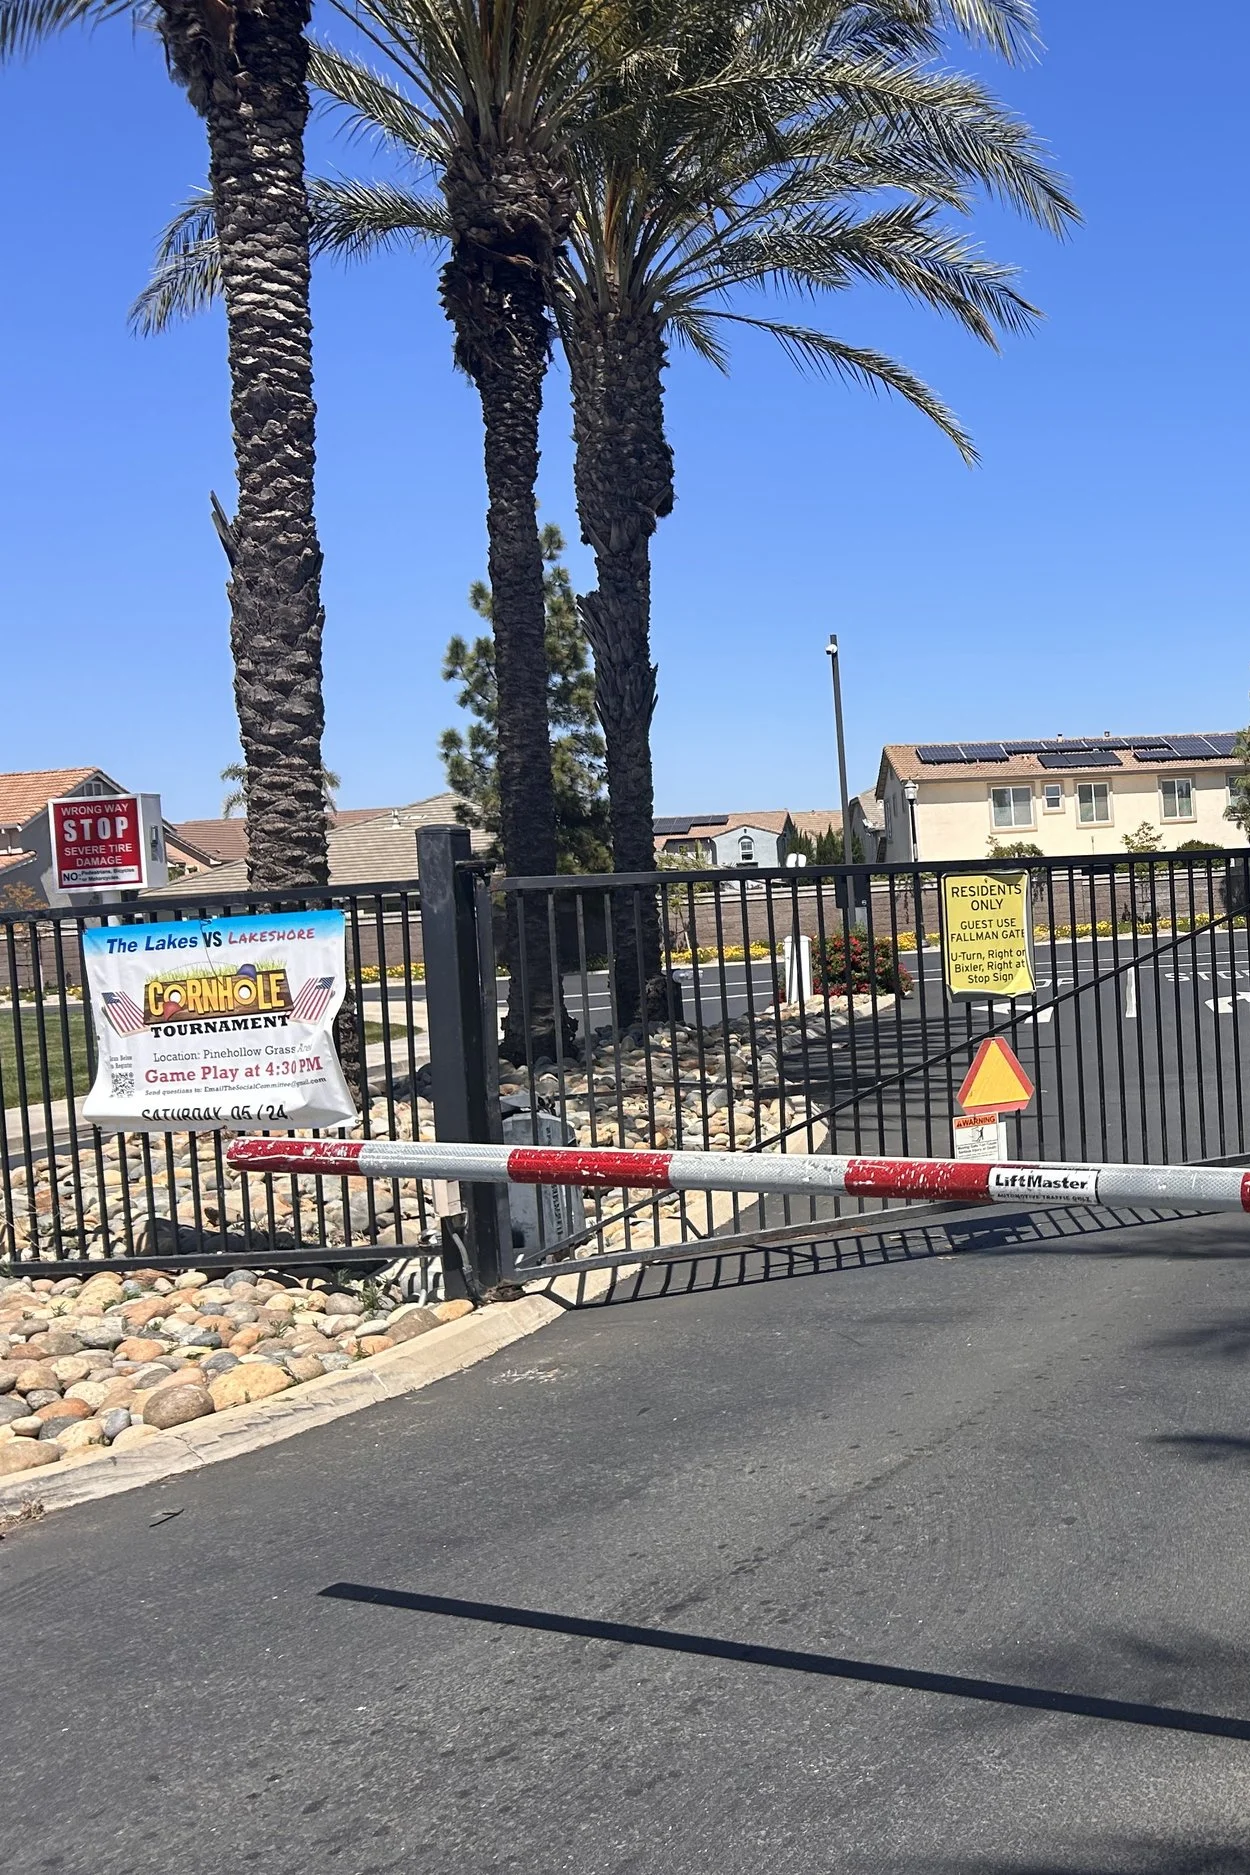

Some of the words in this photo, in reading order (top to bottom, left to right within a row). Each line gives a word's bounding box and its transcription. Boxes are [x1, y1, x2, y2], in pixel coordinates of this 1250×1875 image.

[61, 805, 102, 816] WRONG
[104, 803, 129, 813] WAY
[63, 816, 129, 842] STOP
[64, 845, 106, 856] SEVERE
[109, 843, 133, 853] TIRE
[76, 856, 123, 867] DAMAGE
[951, 883, 1022, 898] RESIDENTS
[971, 898, 1004, 911] ONLY
[960, 919, 993, 930] GUEST
[997, 917, 1017, 928] USE
[106, 937, 138, 954] The
[144, 933, 198, 951] Lakes
[202, 931, 222, 948] VS
[228, 927, 316, 944] LAKESHORE
[950, 930, 999, 942] FALLMAN
[950, 951, 985, 962] U-Turn,
[987, 948, 1013, 960] Right
[954, 963, 984, 973] Bixler,
[987, 960, 1013, 972] Right
[1015, 959, 1025, 968] at
[967, 974, 990, 984] Stop
[992, 972, 1014, 982] Sign
[148, 972, 286, 1017] CORNHOLE
[150, 1015, 289, 1038] TOURNAMENT
[153, 1051, 201, 1062] Location:
[203, 1046, 262, 1059] Pinehollow
[264, 1045, 296, 1056] Grass
[144, 1069, 196, 1083] Game
[201, 1065, 239, 1082] Play
[244, 1063, 260, 1077] at
[265, 1060, 297, 1076] 4:30
[299, 1055, 323, 1073] PM
[161, 1088, 193, 1096] questions
[962, 1115, 996, 1127] WARNING
[995, 1173, 1088, 1189] LiftMaster
